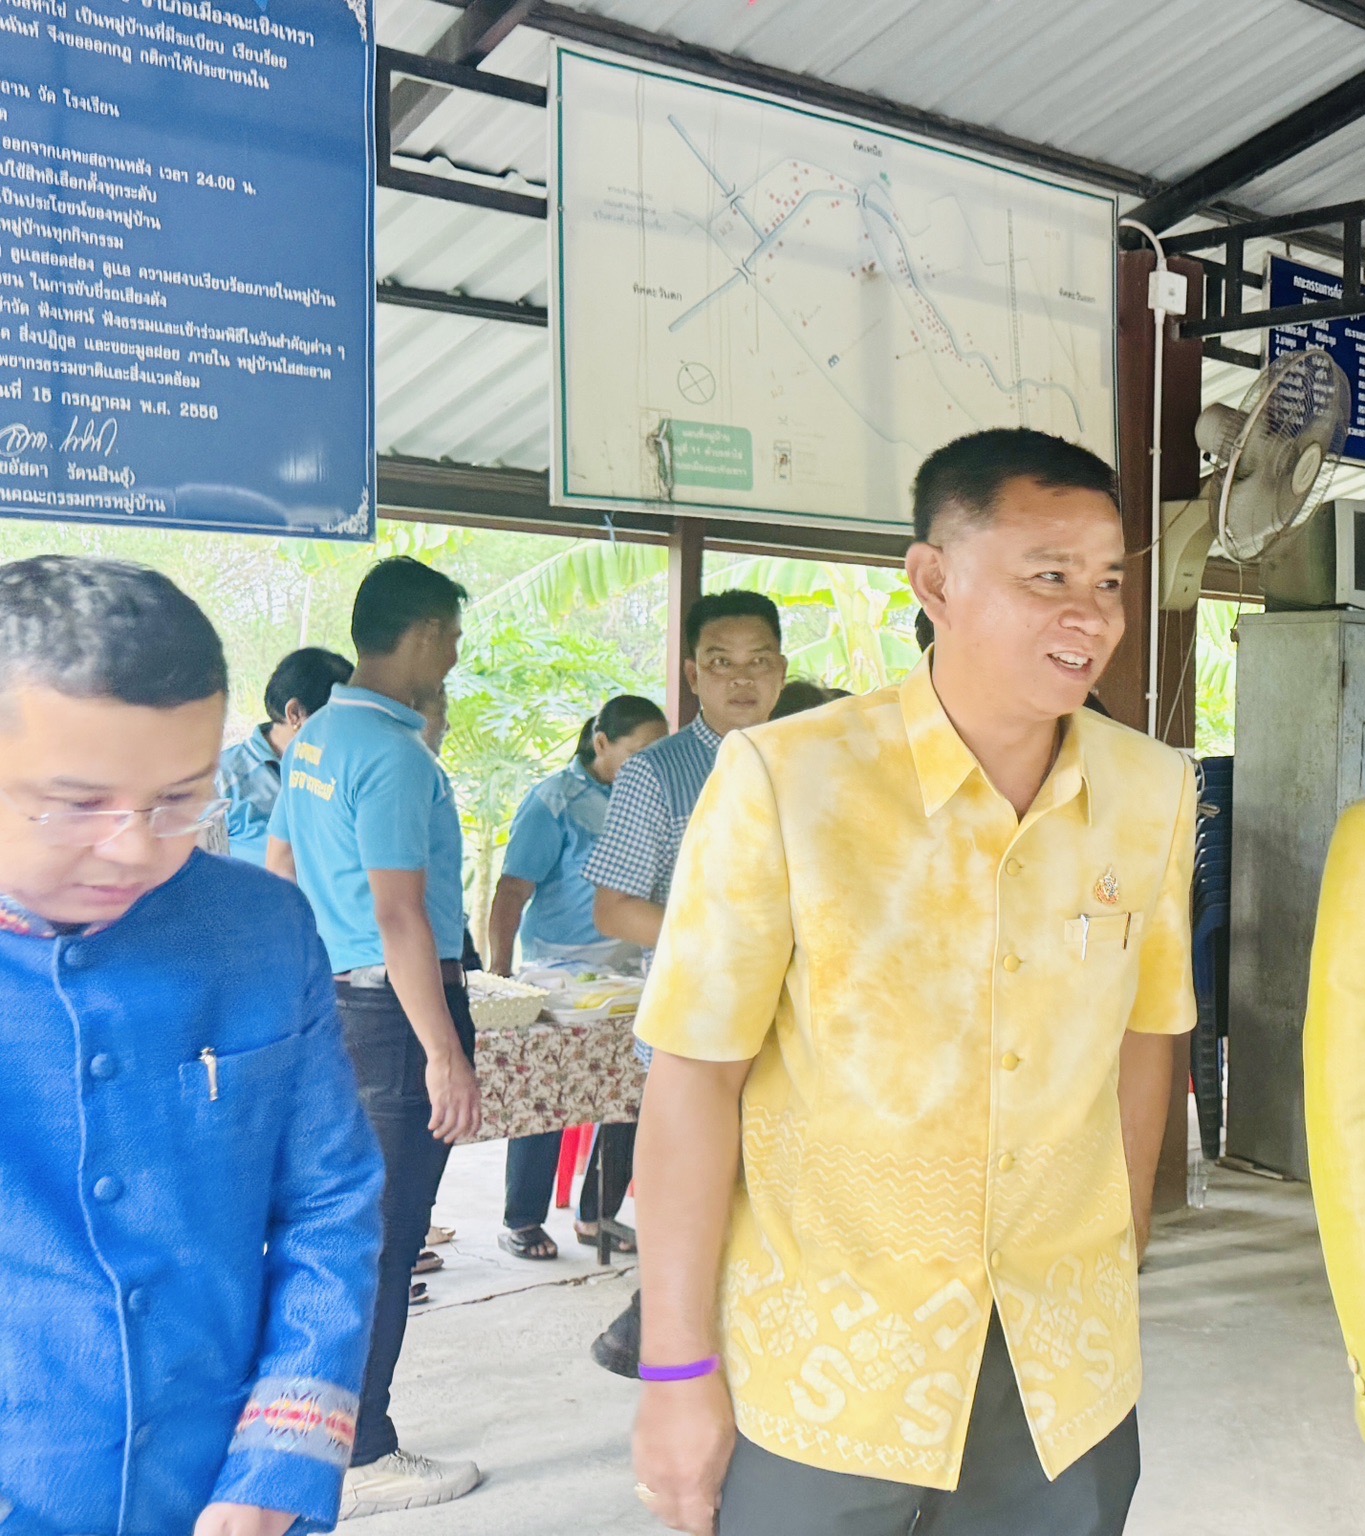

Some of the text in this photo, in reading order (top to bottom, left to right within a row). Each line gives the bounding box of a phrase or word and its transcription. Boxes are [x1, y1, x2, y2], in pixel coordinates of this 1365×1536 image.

[232, 42, 288, 70] เรียบร้อย
[62, 87, 120, 118] โรงเรียน
[160, 166, 189, 183] เวลา
[196, 171, 236, 191] 24.00
[61, 391, 131, 412] กรกฎาคม
[140, 401, 171, 415] พ.ศ.
